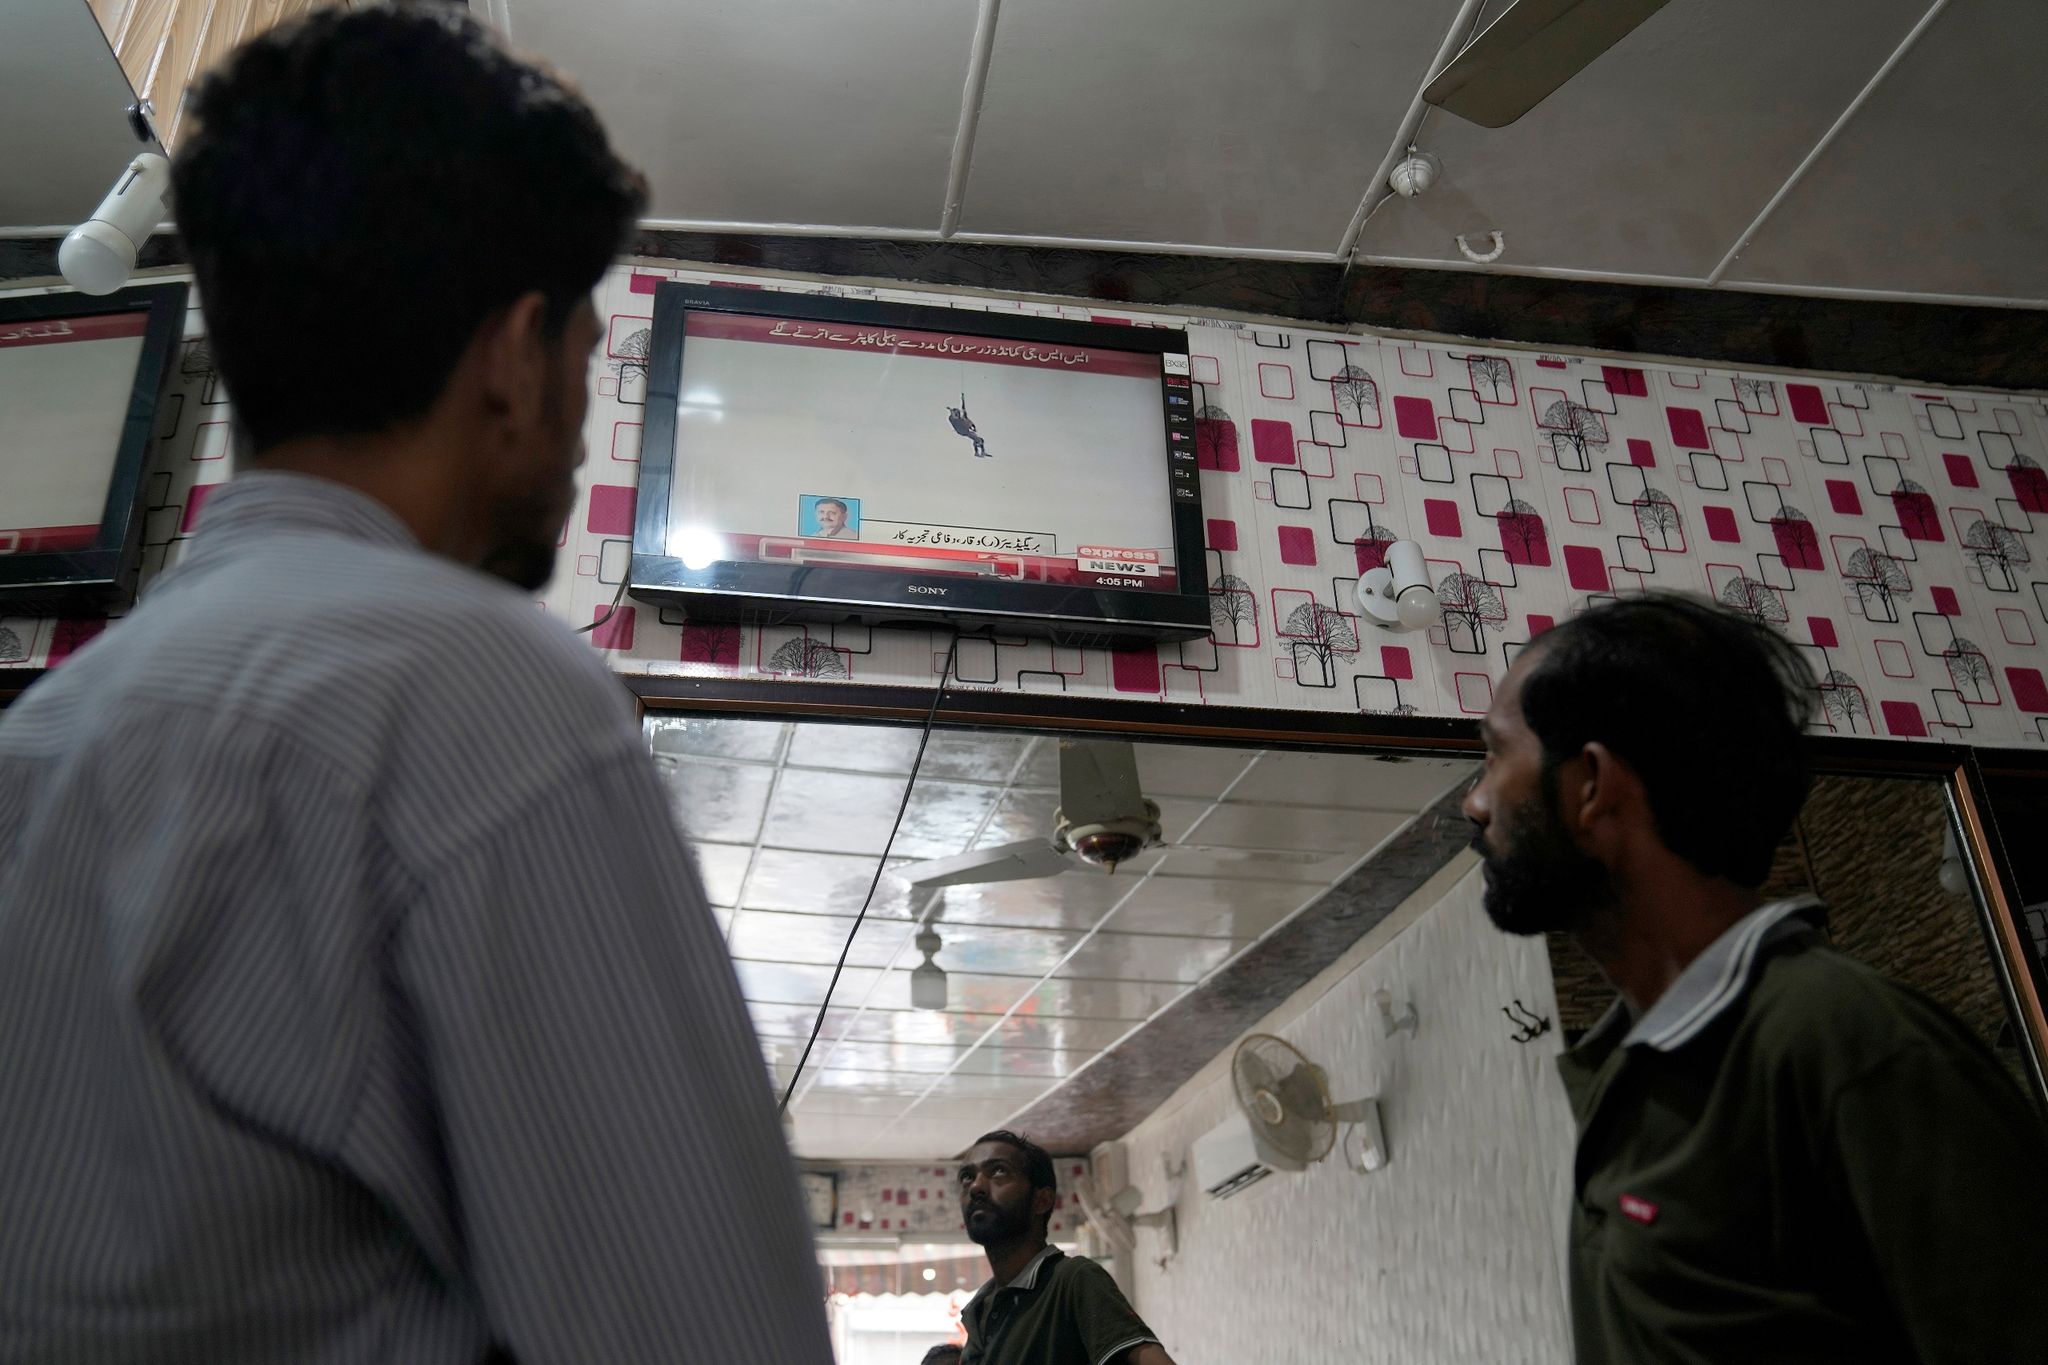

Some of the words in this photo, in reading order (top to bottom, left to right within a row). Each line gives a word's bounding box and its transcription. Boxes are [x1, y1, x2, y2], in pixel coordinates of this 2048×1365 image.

[828, 334, 850, 342] سے
[897, 339, 918, 348] سے
[937, 337, 953, 352] کی
[1022, 347, 1037, 361] جی
[892, 529, 908, 540] کار
[1079, 547, 1156, 560] express
[1090, 561, 1146, 573] NEWS
[1096, 577, 1121, 586] 4:05
[1123, 579, 1143, 588] PM
[908, 585, 948, 595] SONY
